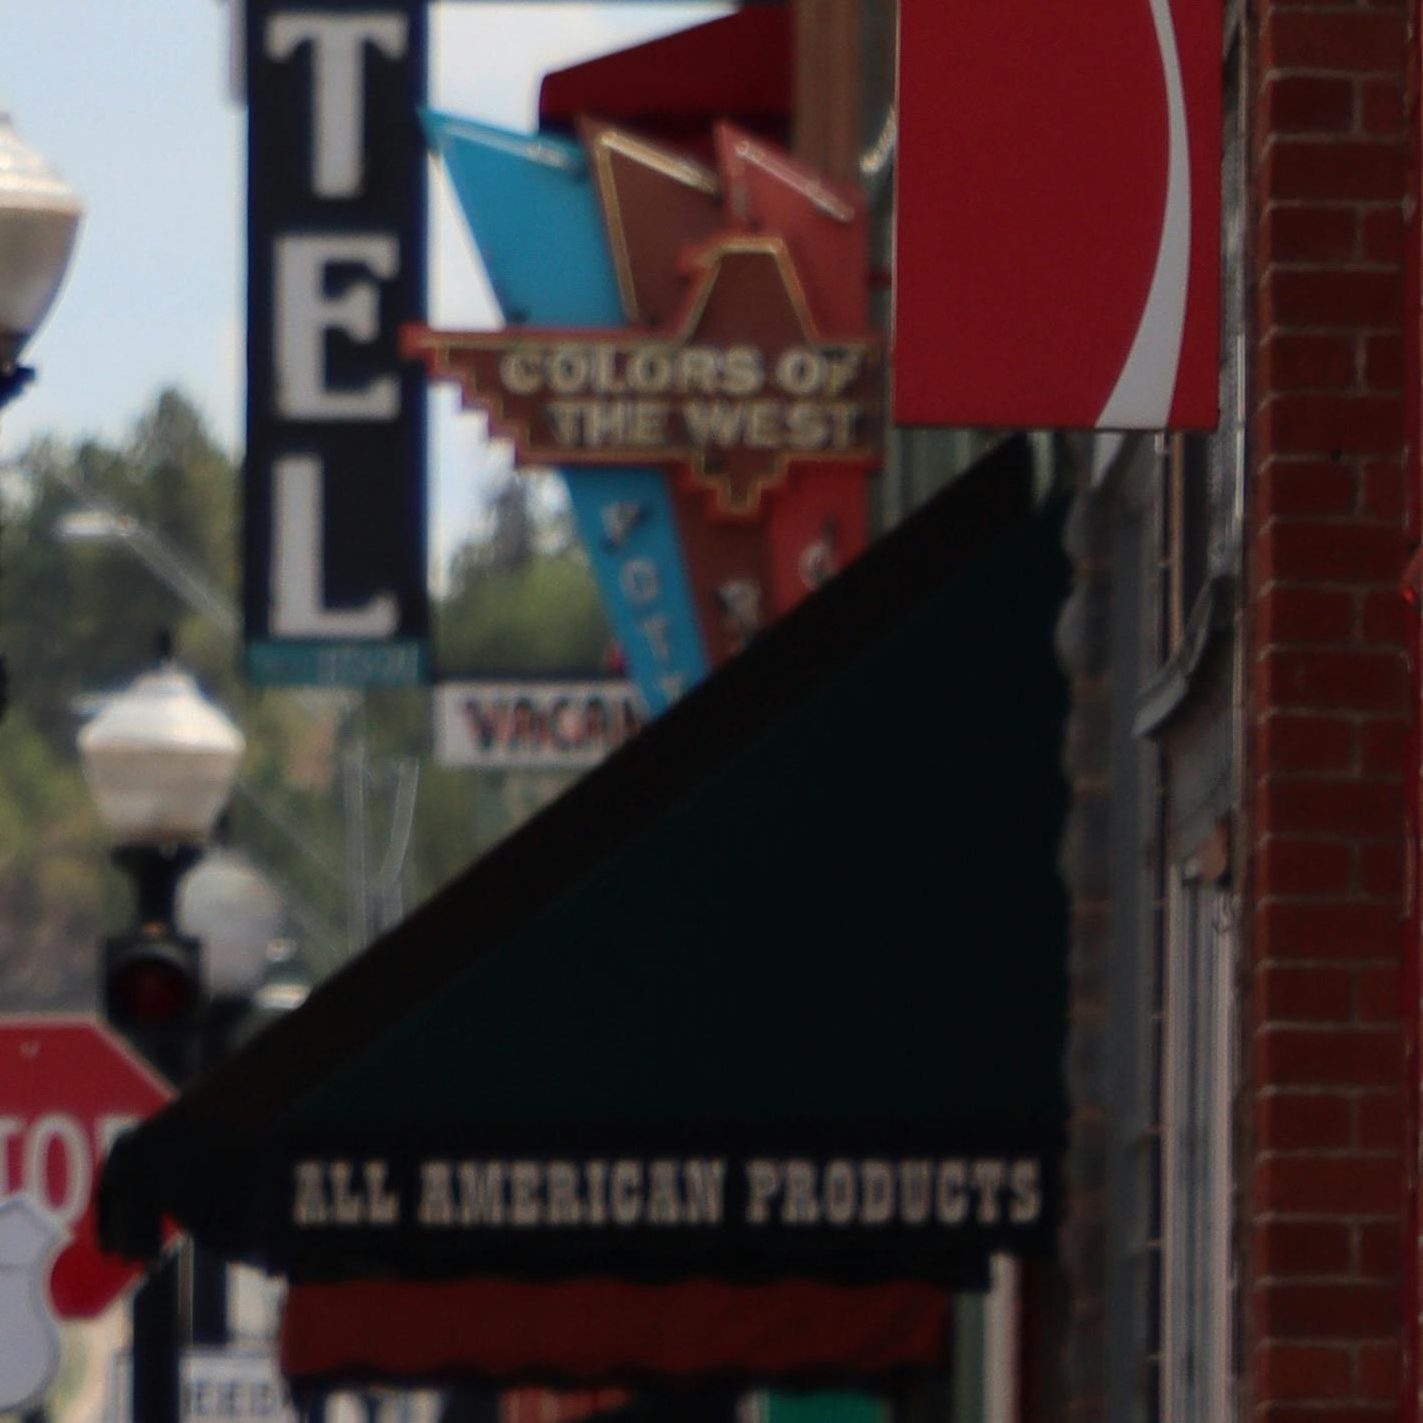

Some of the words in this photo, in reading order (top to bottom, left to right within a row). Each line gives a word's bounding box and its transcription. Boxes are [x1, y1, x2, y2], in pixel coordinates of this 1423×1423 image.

[499, 340, 765, 396] COLORS
[547, 398, 667, 448] THE
[682, 400, 857, 448] WEST
[294, 1162, 398, 1223] ALL
[418, 1162, 724, 1223] AMERICAN
[746, 1162, 1040, 1223] PRODUCTS
